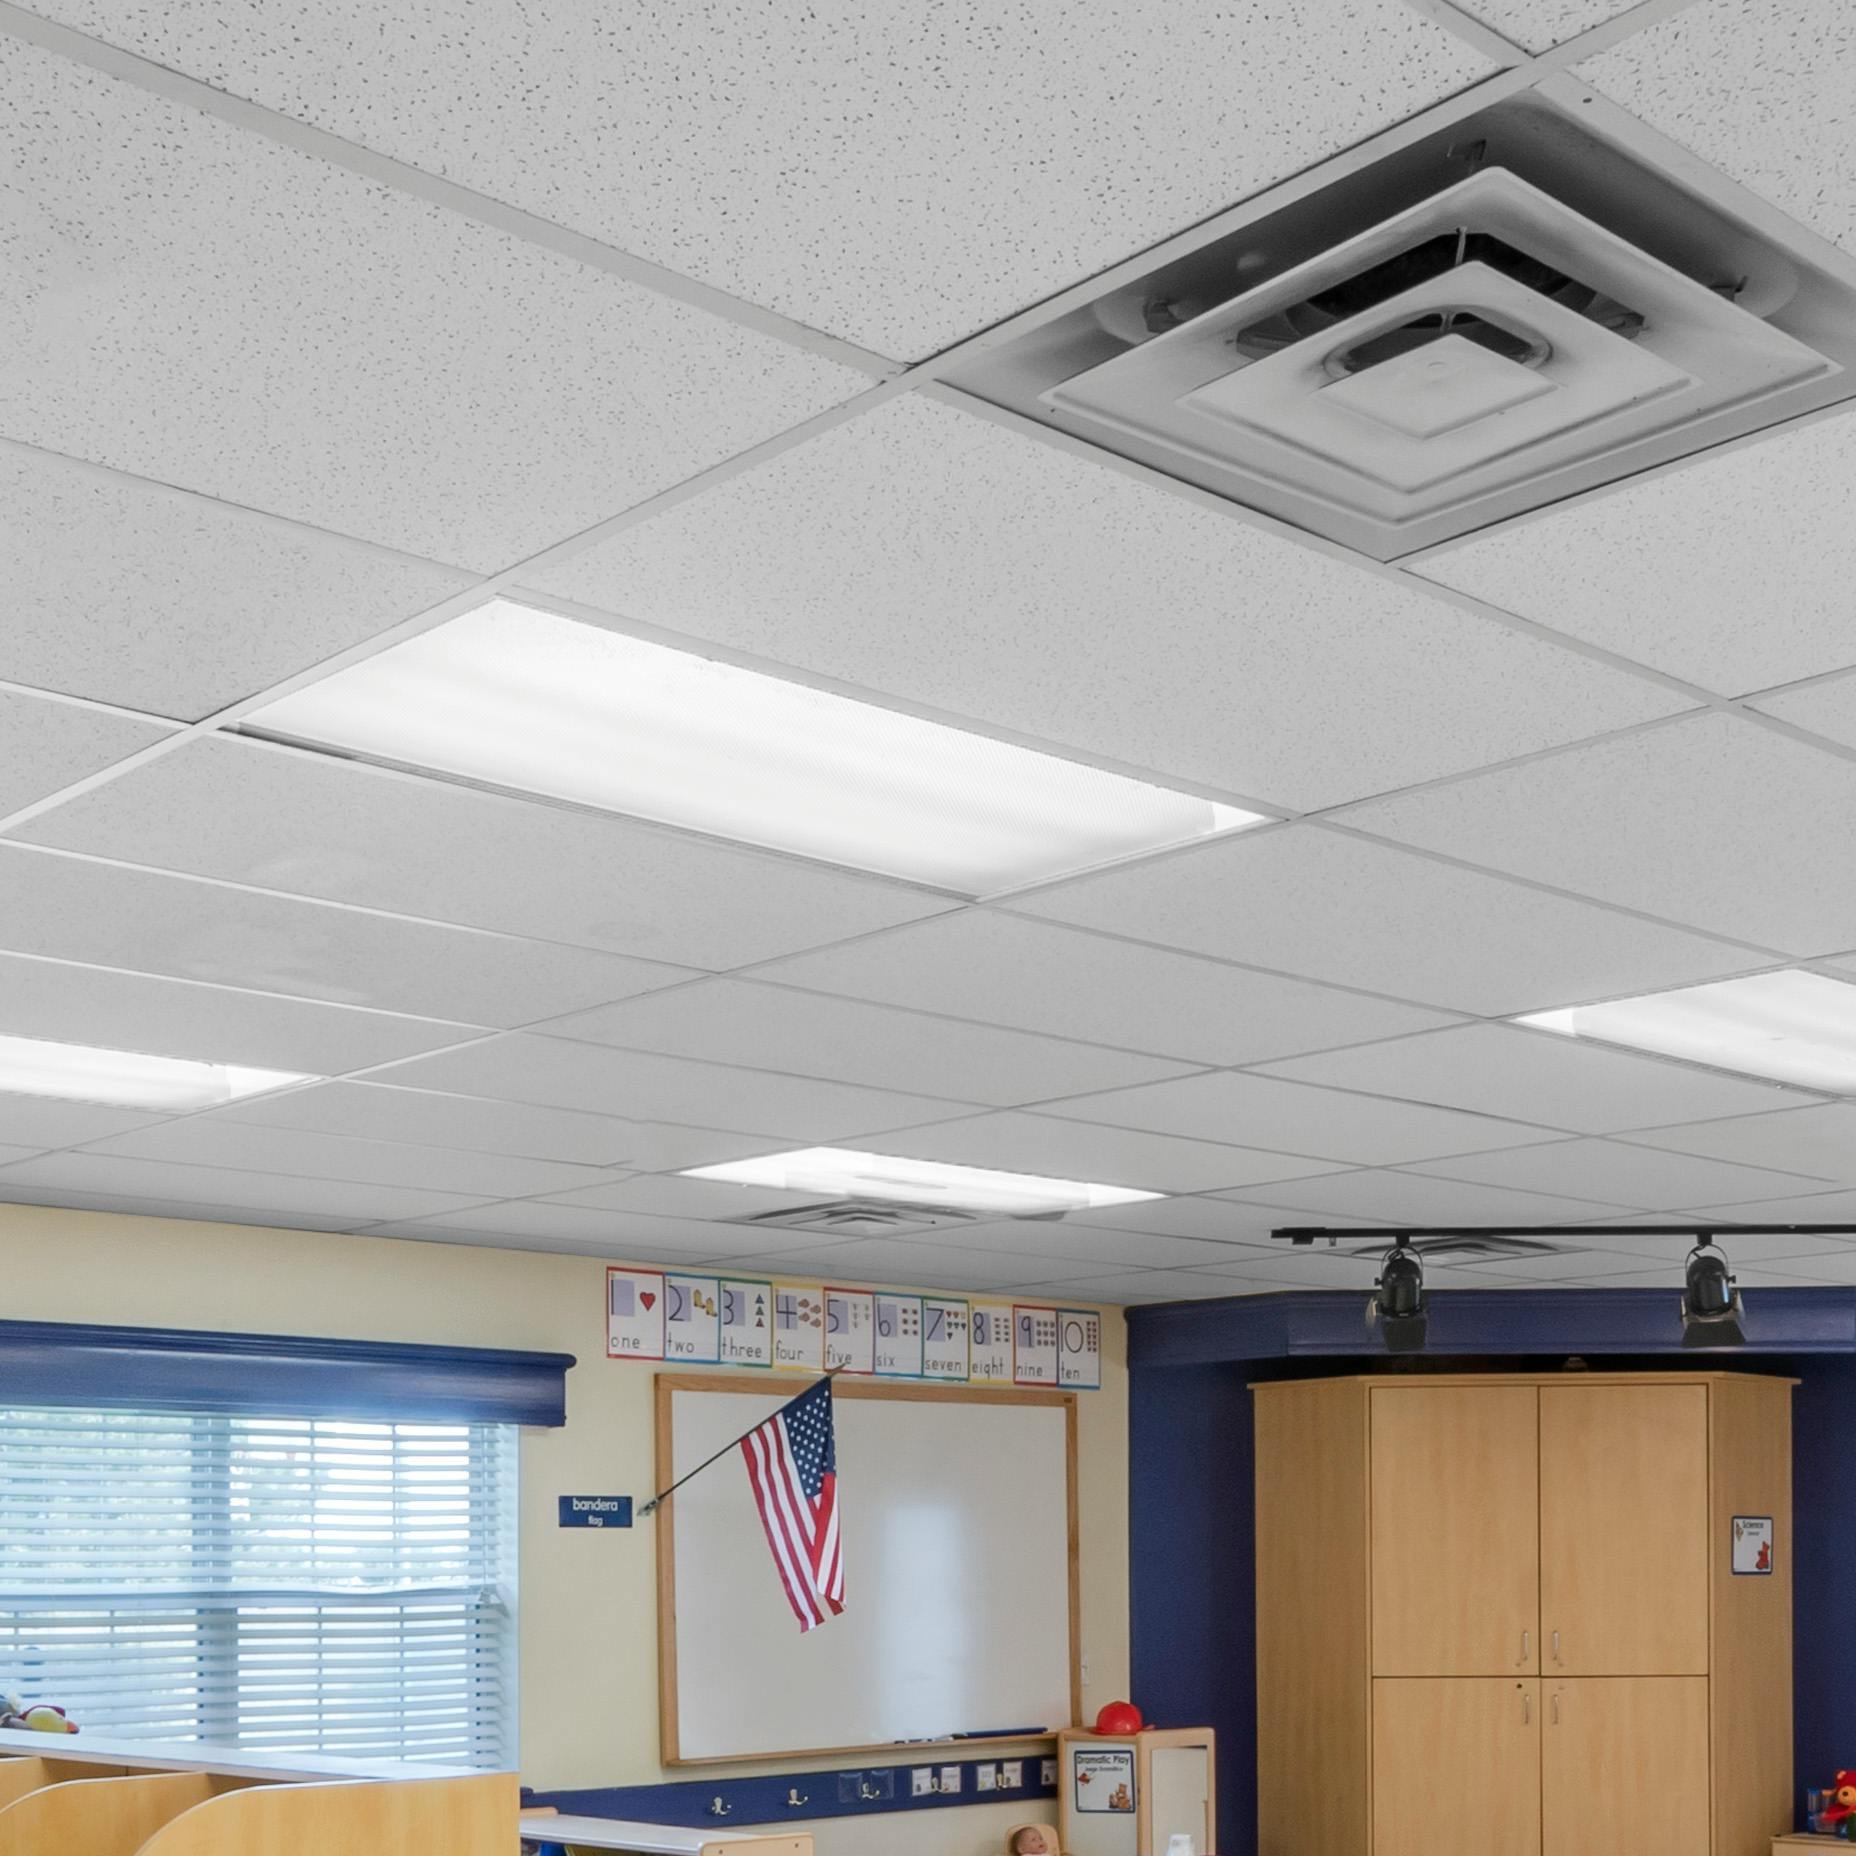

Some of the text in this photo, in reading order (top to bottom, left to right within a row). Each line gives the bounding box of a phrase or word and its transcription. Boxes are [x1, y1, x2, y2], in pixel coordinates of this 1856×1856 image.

[667, 1284, 685, 1321] 2
[722, 1289, 735, 1325] 3
[775, 1294, 797, 1329] 4
[827, 1299, 841, 1333] 5
[877, 1303, 892, 1337] 6
[926, 1307, 944, 1341] 7
[973, 1312, 986, 1345] 8
[1020, 1315, 1033, 1348] 9
[1060, 1321, 1085, 1354] 10
[611, 1335, 641, 1349] one
[667, 1332, 695, 1353] two
[722, 1336, 763, 1359] three
[775, 1340, 804, 1361] four
[826, 1344, 853, 1366] five
[876, 1351, 896, 1367] six
[925, 1357, 963, 1372] seven
[972, 1356, 1005, 1381] eight
[1016, 1361, 1044, 1377] nine
[1061, 1364, 1082, 1380] ten
[572, 1497, 619, 1511] bandera
[1076, 1755, 1129, 1766] Dramatic Play
